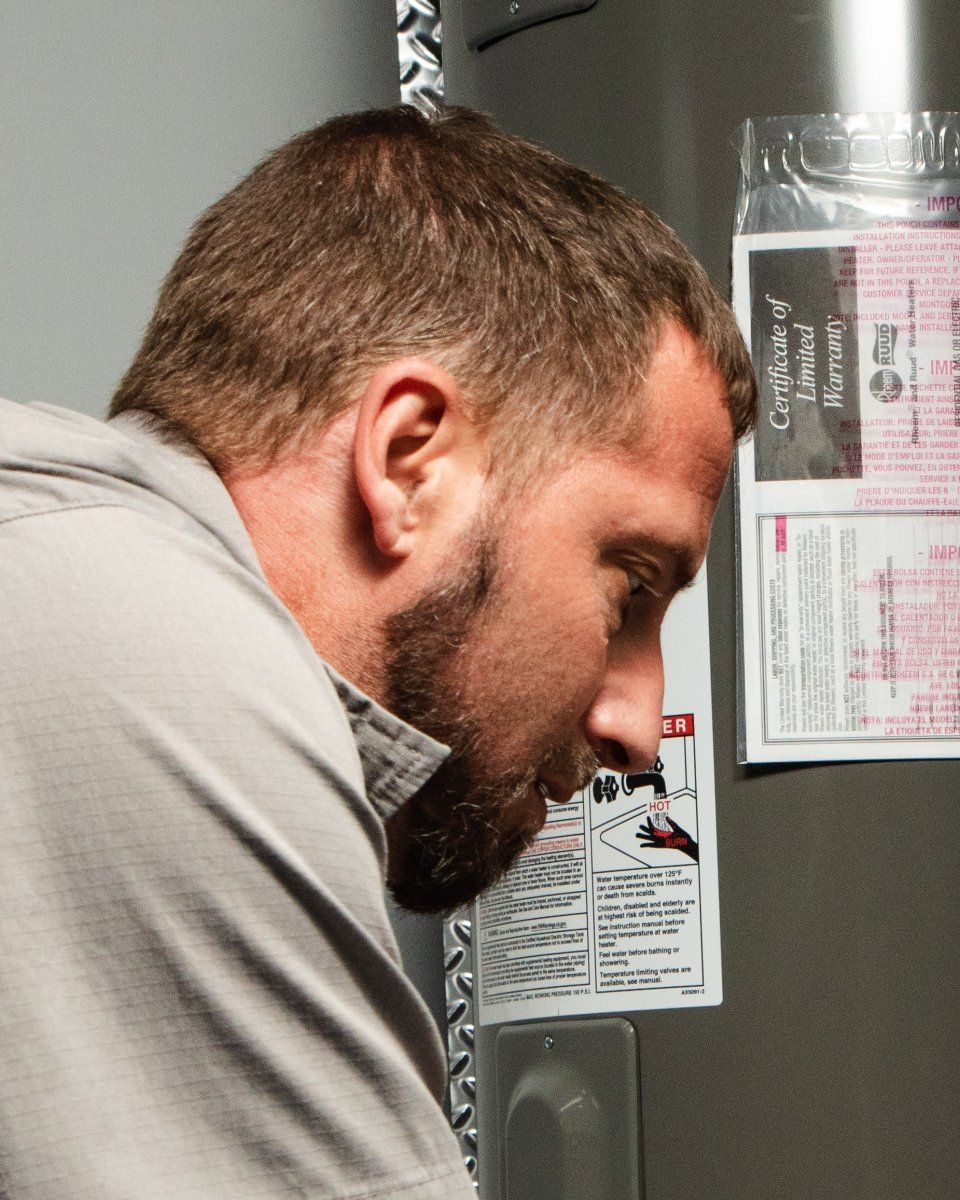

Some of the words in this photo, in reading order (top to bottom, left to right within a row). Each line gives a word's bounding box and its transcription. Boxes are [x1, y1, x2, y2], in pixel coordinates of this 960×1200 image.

[766, 294, 791, 319] of
[880, 324, 891, 365] RUUD
[794, 324, 816, 403] Limited
[823, 315, 847, 408] Warranty
[768, 325, 794, 429] Certificate
[649, 801, 671, 811] HOT
[665, 838, 687, 847] BURN
[614, 874, 648, 883] temperature
[666, 878, 692, 886] instantly
[663, 899, 683, 908] elderly
[610, 922, 639, 930] instruction
[599, 932, 616, 940] setting
[618, 930, 653, 938] temperature
[629, 948, 647, 956] before
[649, 947, 671, 955] bathing
[600, 970, 634, 979] Temperature
[636, 968, 658, 976] limiting
